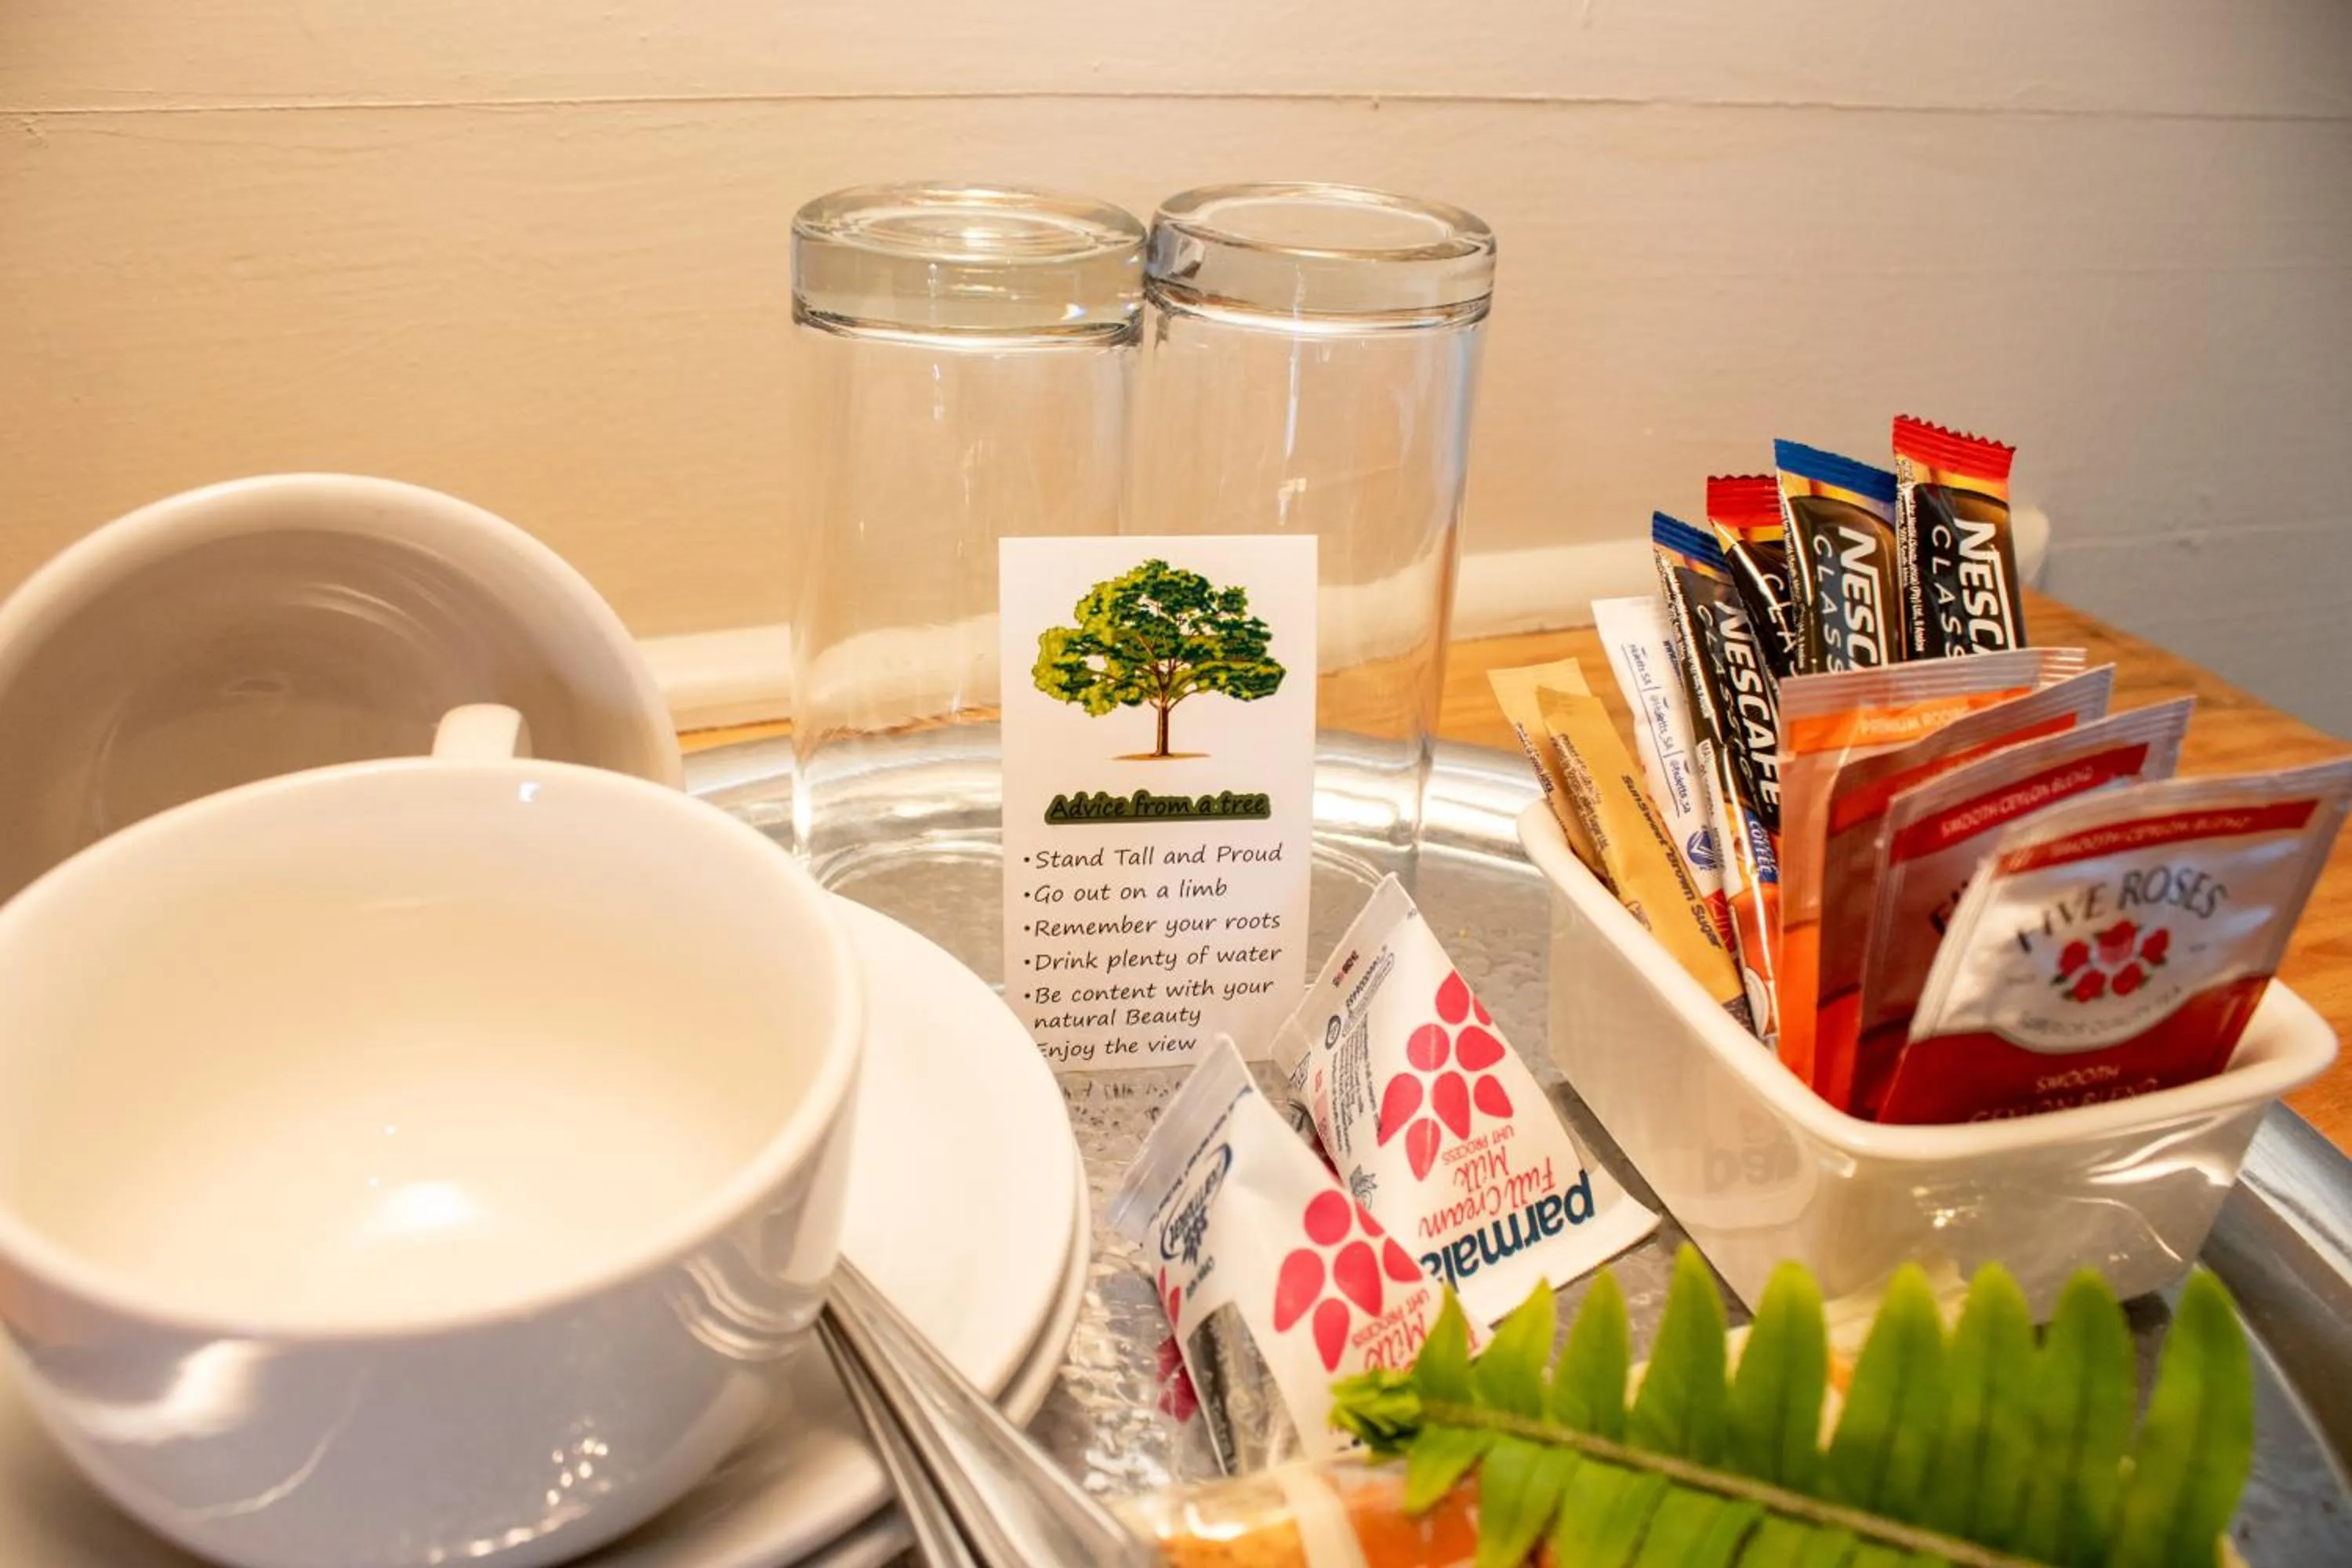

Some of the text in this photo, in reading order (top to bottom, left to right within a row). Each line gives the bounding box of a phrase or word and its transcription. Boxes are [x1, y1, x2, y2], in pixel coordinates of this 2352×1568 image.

[1050, 790, 1267, 818] Advice from a tree
[1036, 843, 1283, 869] Stand Tall and Proud
[1034, 878, 1228, 903] Go out on a limb
[2118, 865, 2229, 920] ROSES
[1035, 912, 1281, 938] Remember your roots
[1687, 898, 1723, 950] Sugar
[1035, 946, 1283, 974] Drink plenty of water
[1035, 978, 1274, 1004] Be content with your
[1034, 1007, 1202, 1029] natural Beauty
[1105, 1037, 1138, 1054] the
[1148, 1034, 1197, 1052] view
[2035, 1065, 2120, 1094] SMOOTH
[1441, 1124, 1515, 1166] UHT PROCESS
[1454, 1145, 1509, 1192] Milk
[1418, 1156, 1556, 1238] Full Cream
[1406, 1288, 1431, 1314] UHT
